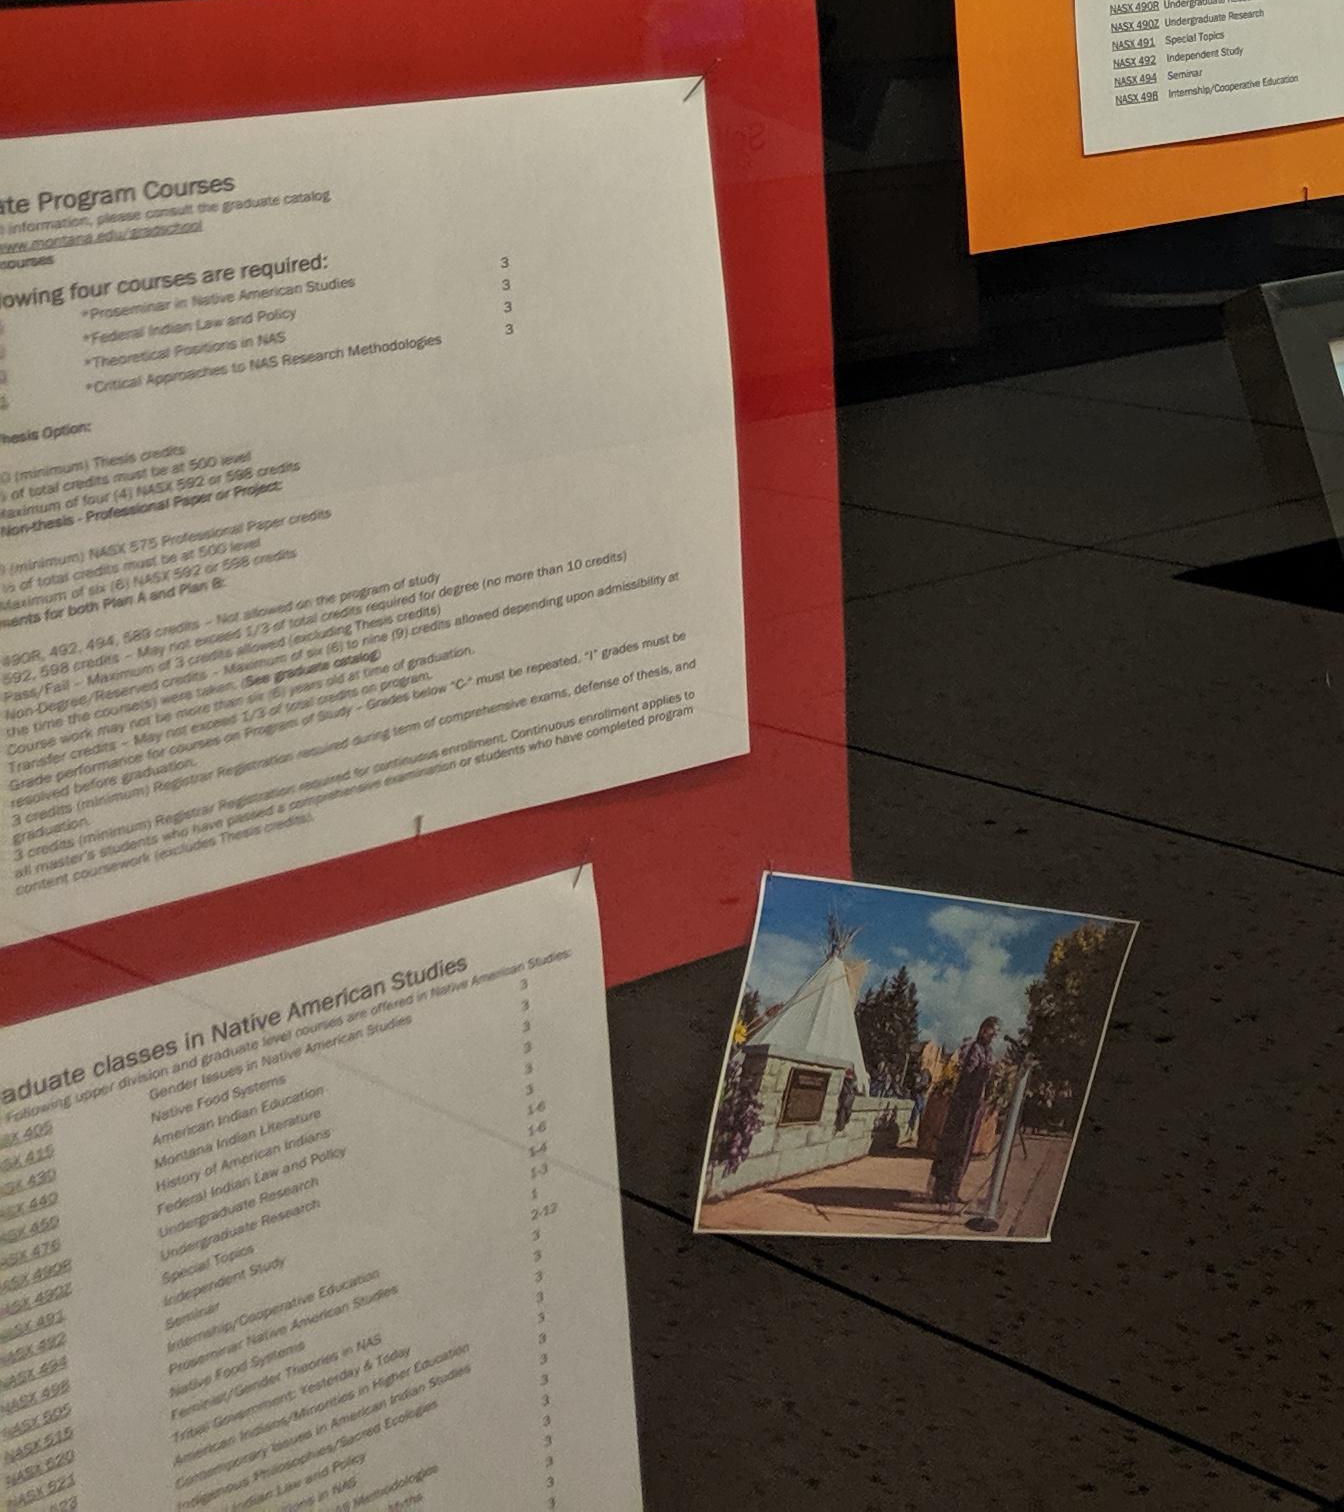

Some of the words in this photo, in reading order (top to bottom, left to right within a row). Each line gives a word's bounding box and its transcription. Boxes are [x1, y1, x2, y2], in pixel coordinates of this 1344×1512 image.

[1111, 38, 1137, 52] NASX
[1135, 36, 1156, 50] 491
[1164, 32, 1197, 46] Special
[1196, 30, 1225, 42] Topics
[36, 186, 136, 211] Program
[141, 176, 236, 200] Courses
[68, 281, 112, 299] four
[116, 271, 198, 294] courses
[200, 266, 235, 284] are
[239, 253, 328, 279] required:
[173, 298, 187, 309] in
[190, 292, 236, 306] Native
[237, 284, 303, 301] American
[304, 277, 356, 293] Studies
[499, 255, 510, 269] 3
[147, 321, 192, 336] Indian
[194, 318, 225, 331] Law
[225, 311, 254, 327] and
[255, 308, 297, 322] Policy
[501, 277, 511, 291] 3
[173, 339, 238, 357] Positions
[238, 337, 254, 348] in
[255, 330, 287, 346] NAS
[503, 300, 512, 314] 3
[145, 365, 228, 386] Approaches
[248, 354, 279, 370] NAS
[280, 347, 344, 365] Research
[346, 335, 442, 356] Methodologies
[504, 322, 514, 335] 3
[92, 1040, 178, 1077] classes
[210, 1010, 282, 1042] Native
[286, 980, 386, 1021] American
[390, 957, 468, 990] Studies
[150, 1103, 194, 1123] Native
[196, 1088, 229, 1109] Food
[231, 1074, 287, 1099] Systems
[153, 1143, 213, 1169] Montana
[215, 1129, 257, 1149] Indian
[258, 1109, 322, 1136] Literature
[160, 1257, 210, 1284] Special
[212, 1244, 255, 1265] Topics
